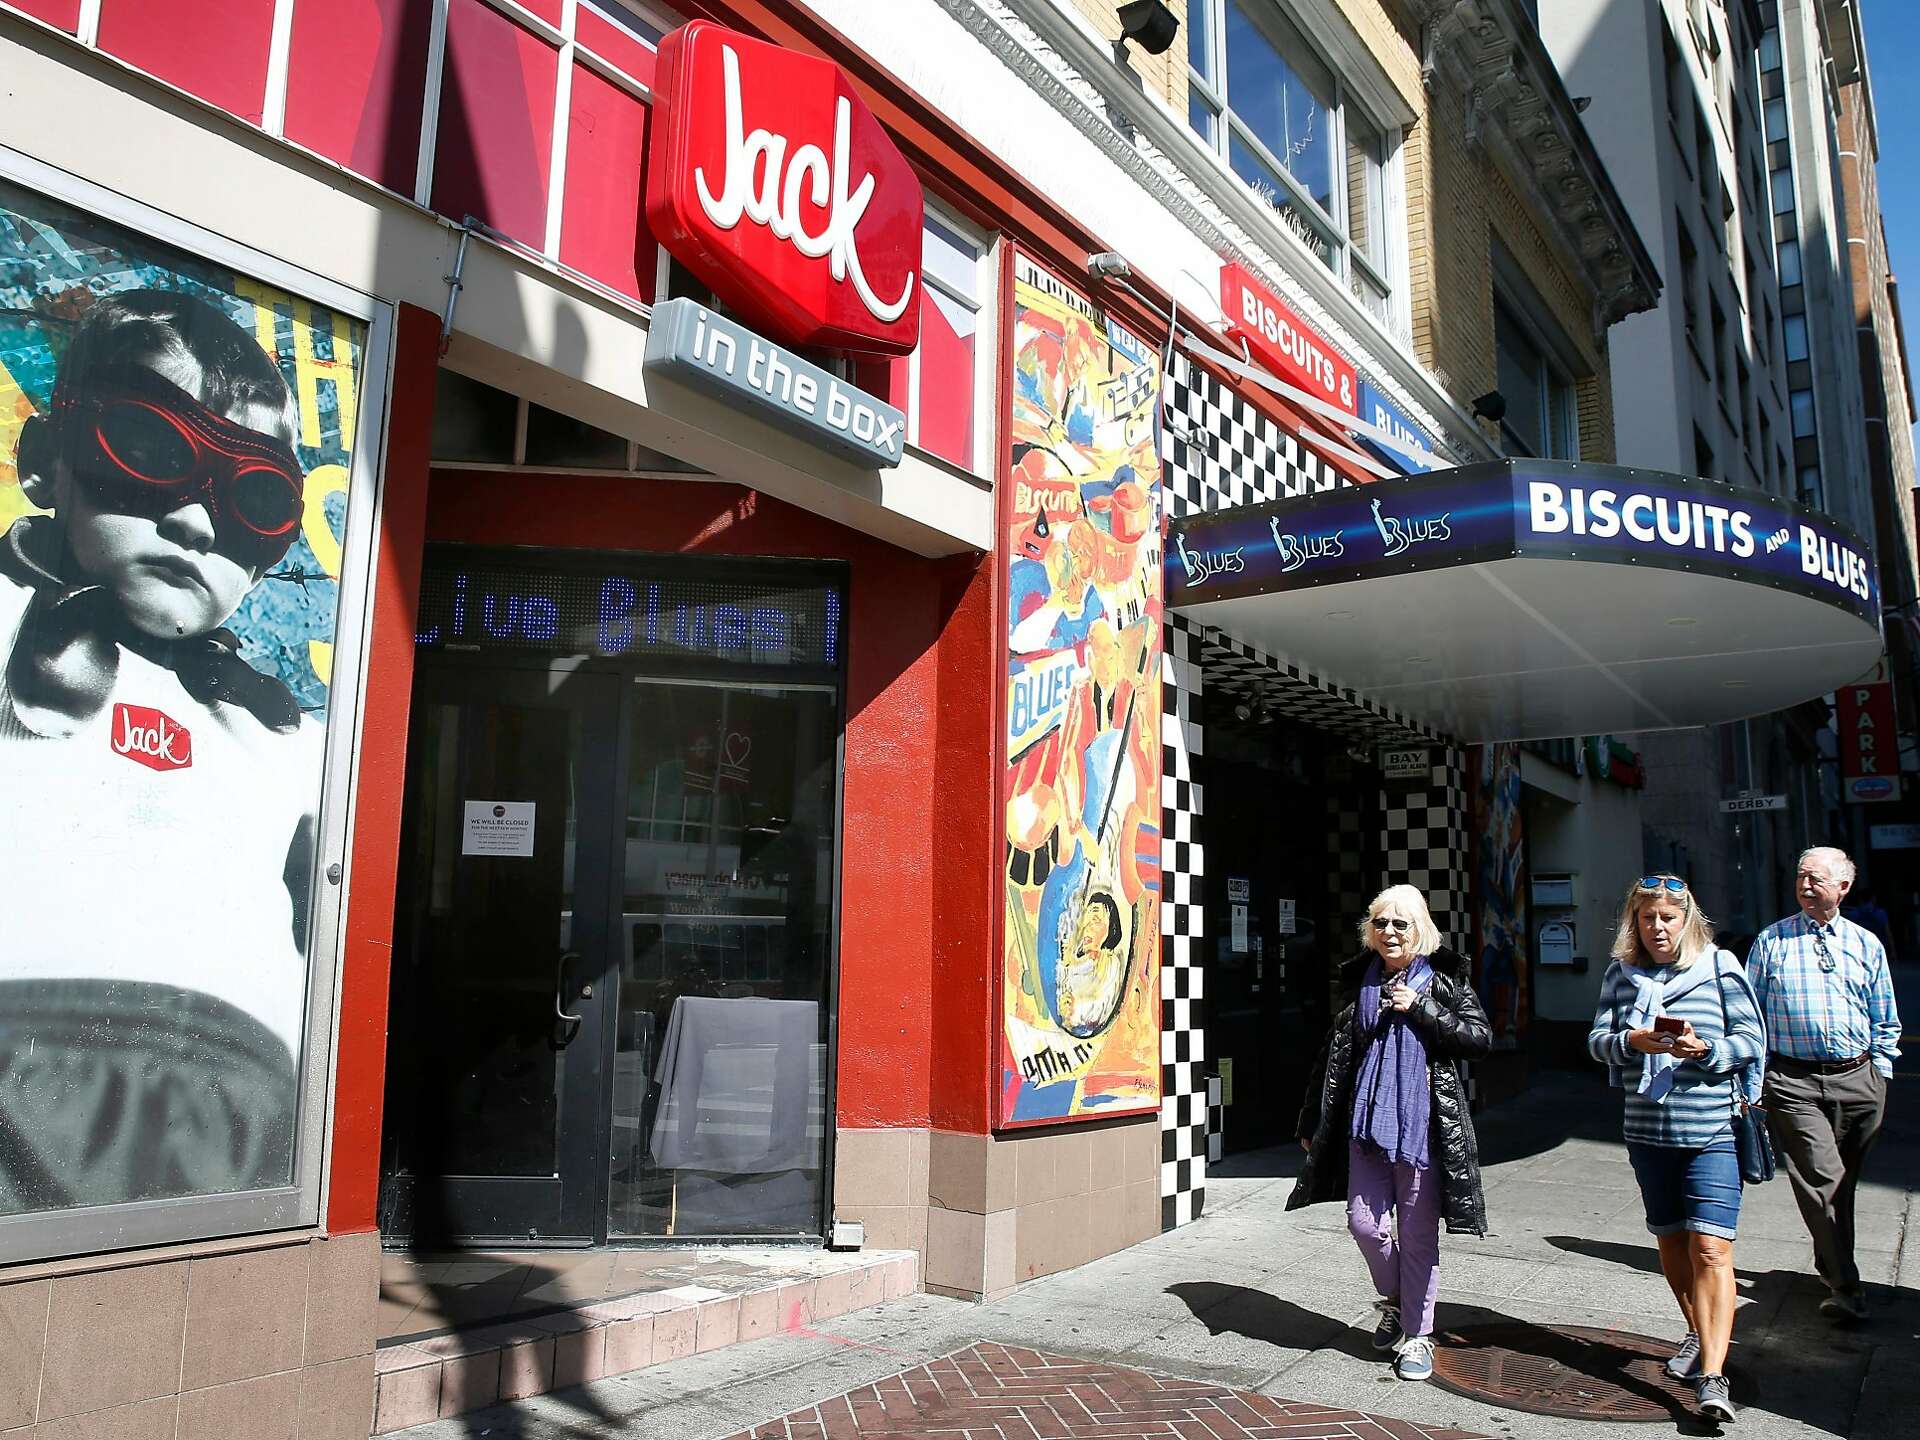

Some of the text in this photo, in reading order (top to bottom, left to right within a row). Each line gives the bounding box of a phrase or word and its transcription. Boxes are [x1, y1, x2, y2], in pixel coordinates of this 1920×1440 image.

[694, 43, 915, 322] Jack
[692, 308, 737, 377] in
[746, 338, 818, 415] the
[1240, 286, 1352, 408] BISCUITS &
[1528, 481, 1870, 601] BISCUITS AND BLUES
[414, 575, 559, 644] ive
[599, 576, 785, 653] Blues
[113, 707, 190, 766] Jack
[1390, 753, 1423, 764] BAY
[1855, 689, 1878, 773] PARK
[1728, 799, 1774, 810] DERBY
